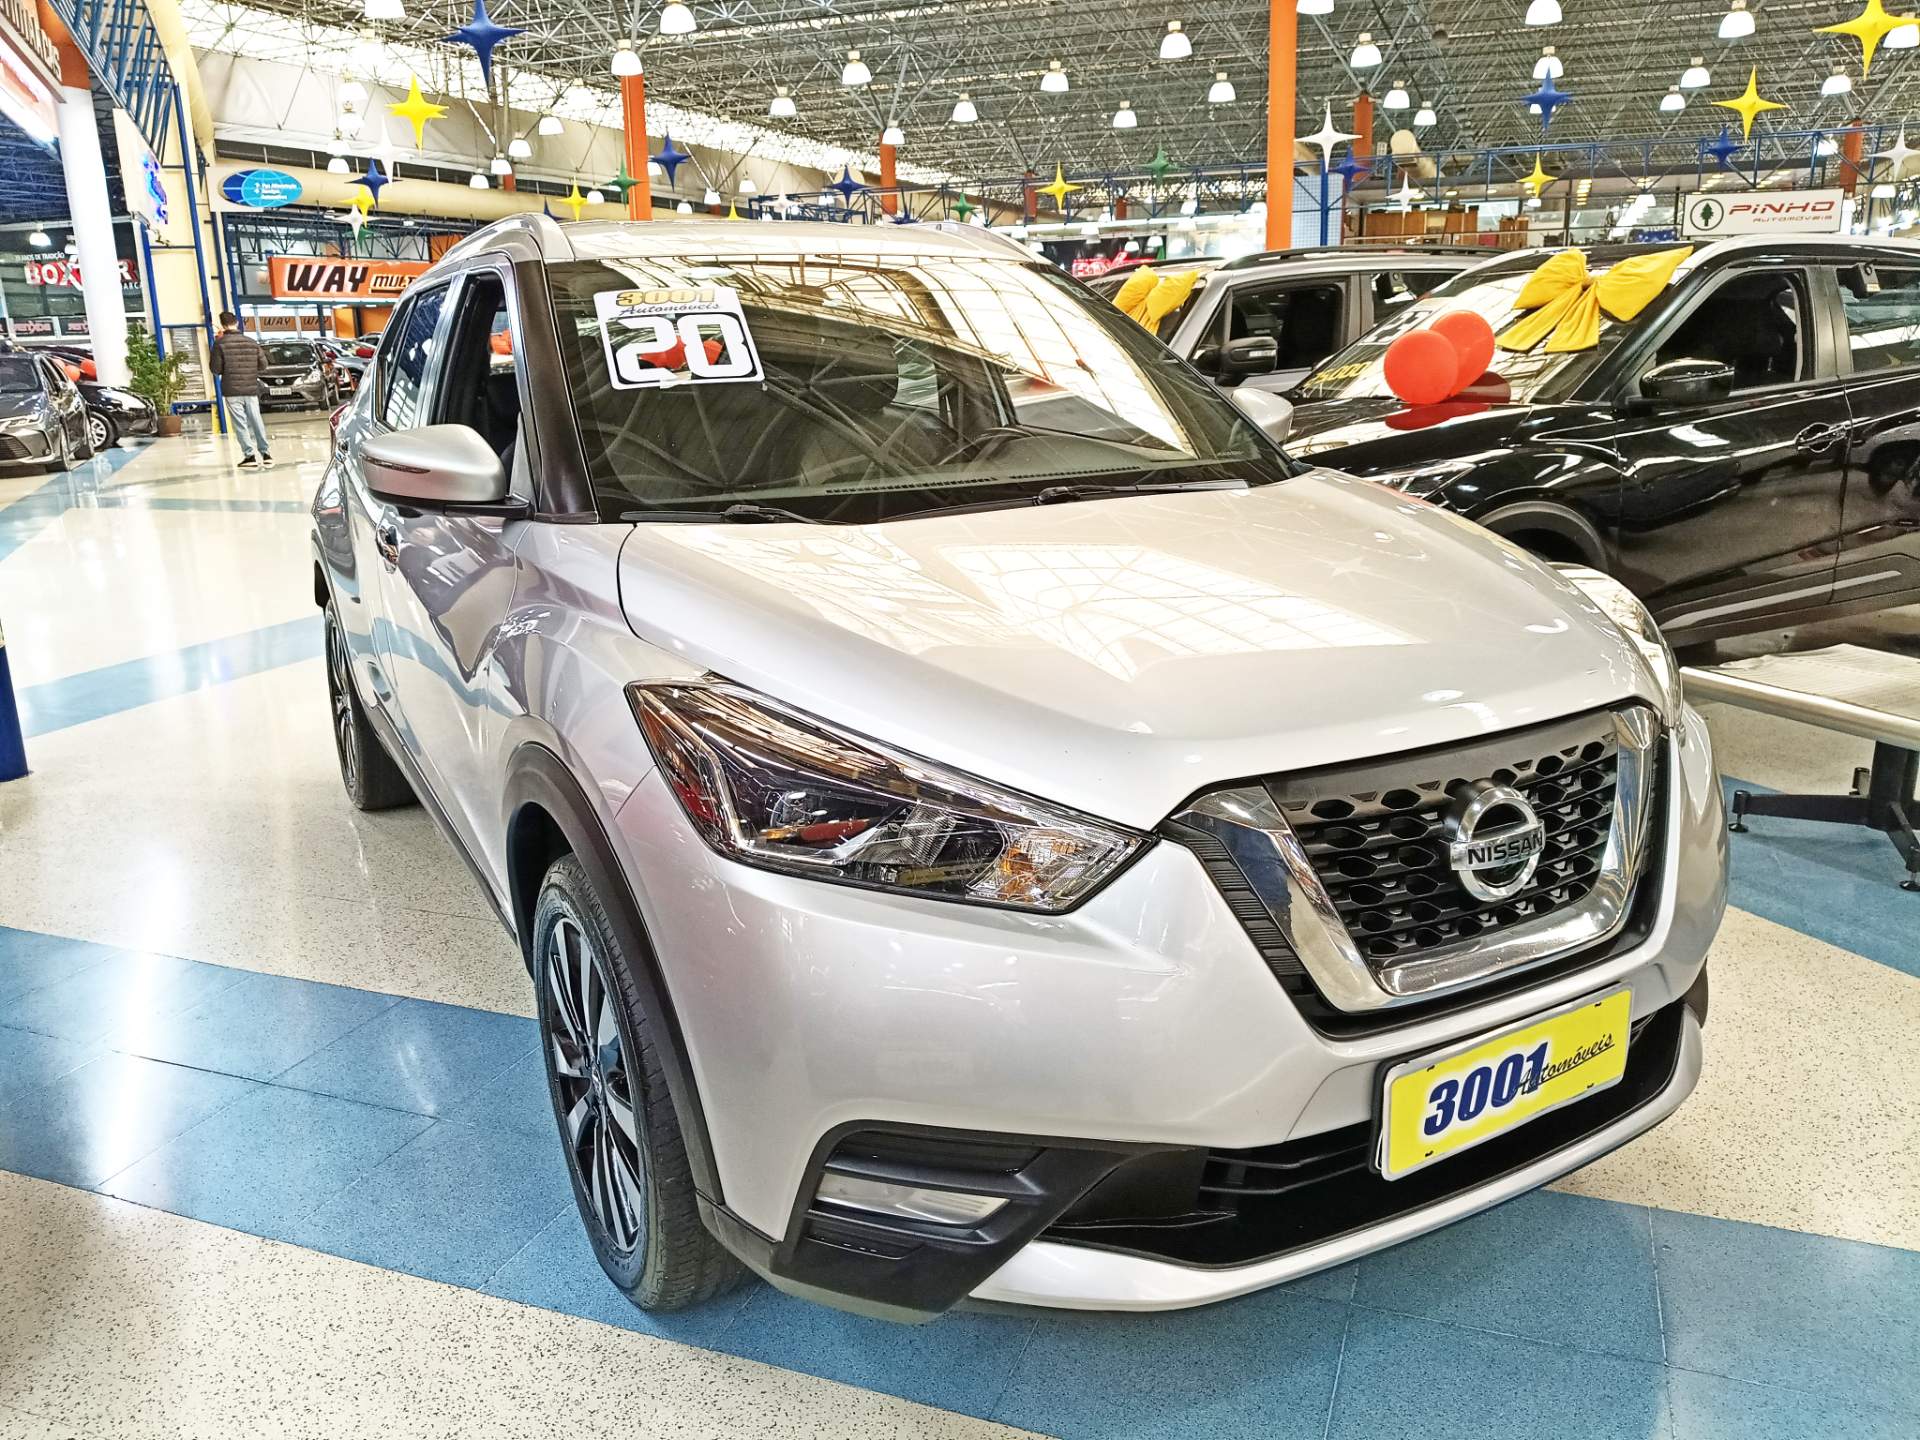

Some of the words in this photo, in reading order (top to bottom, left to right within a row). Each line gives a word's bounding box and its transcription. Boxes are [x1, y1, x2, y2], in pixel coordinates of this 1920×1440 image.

[287, 264, 368, 292] WAY
[616, 289, 715, 306] 3001
[264, 317, 290, 326] WAY
[615, 314, 754, 383] 20
[1467, 832, 1542, 865] NISSAN
[1424, 1042, 1548, 1136] 3001
[1513, 1033, 1613, 1096] Automóveis
